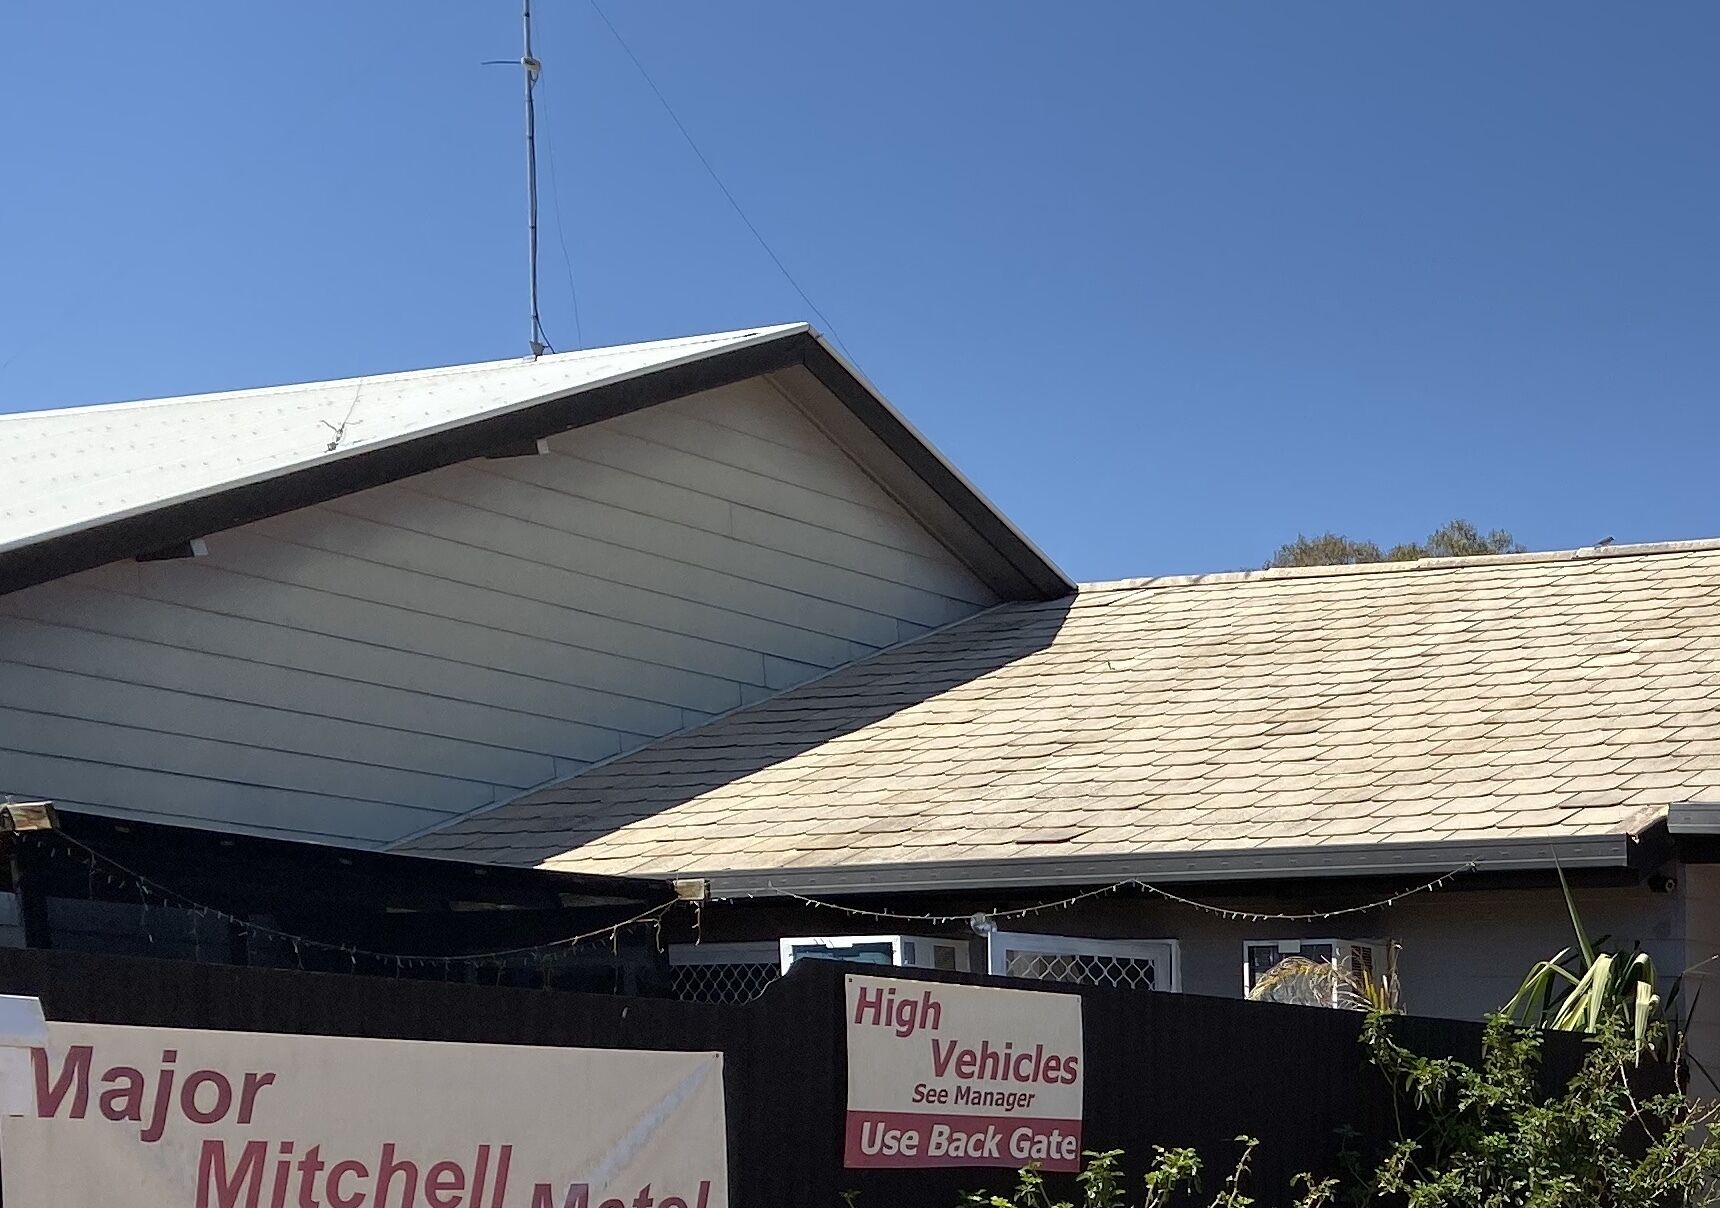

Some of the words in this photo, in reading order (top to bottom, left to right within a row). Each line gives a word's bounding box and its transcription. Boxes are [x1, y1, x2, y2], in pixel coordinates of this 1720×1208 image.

[854, 986, 942, 1037] High
[931, 1038, 1079, 1085] Vehicles
[30, 1045, 276, 1143] Major
[912, 1083, 948, 1104] See
[954, 1085, 1035, 1112] Manager
[861, 1121, 919, 1156] Use
[927, 1123, 1002, 1158] Back
[1009, 1127, 1077, 1160] Gate
